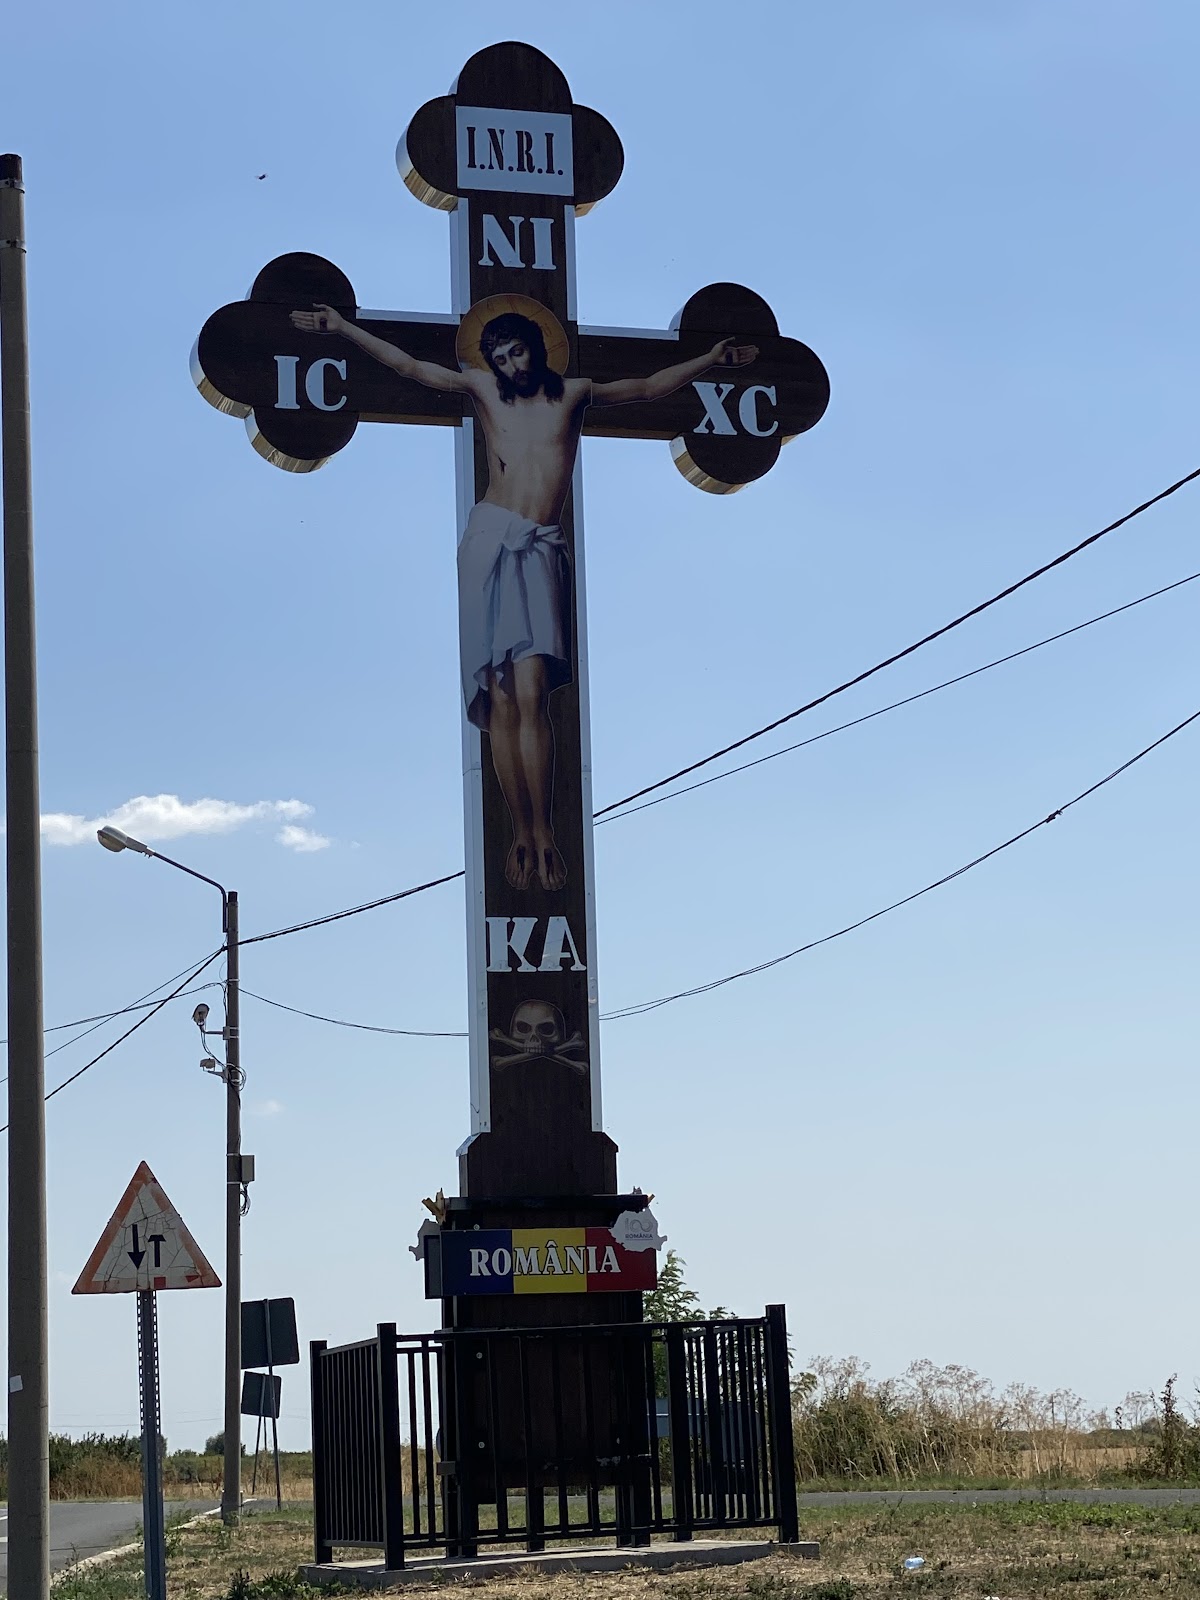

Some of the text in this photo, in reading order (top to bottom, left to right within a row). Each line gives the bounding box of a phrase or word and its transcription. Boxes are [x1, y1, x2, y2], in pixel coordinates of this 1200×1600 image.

[466, 126, 564, 176] I.N.R.I.
[477, 213, 557, 270] NI
[273, 354, 348, 412] IC
[691, 381, 779, 437] XC
[485, 916, 587, 973] KA
[469, 1239, 622, 1277] ROMÂNIA
